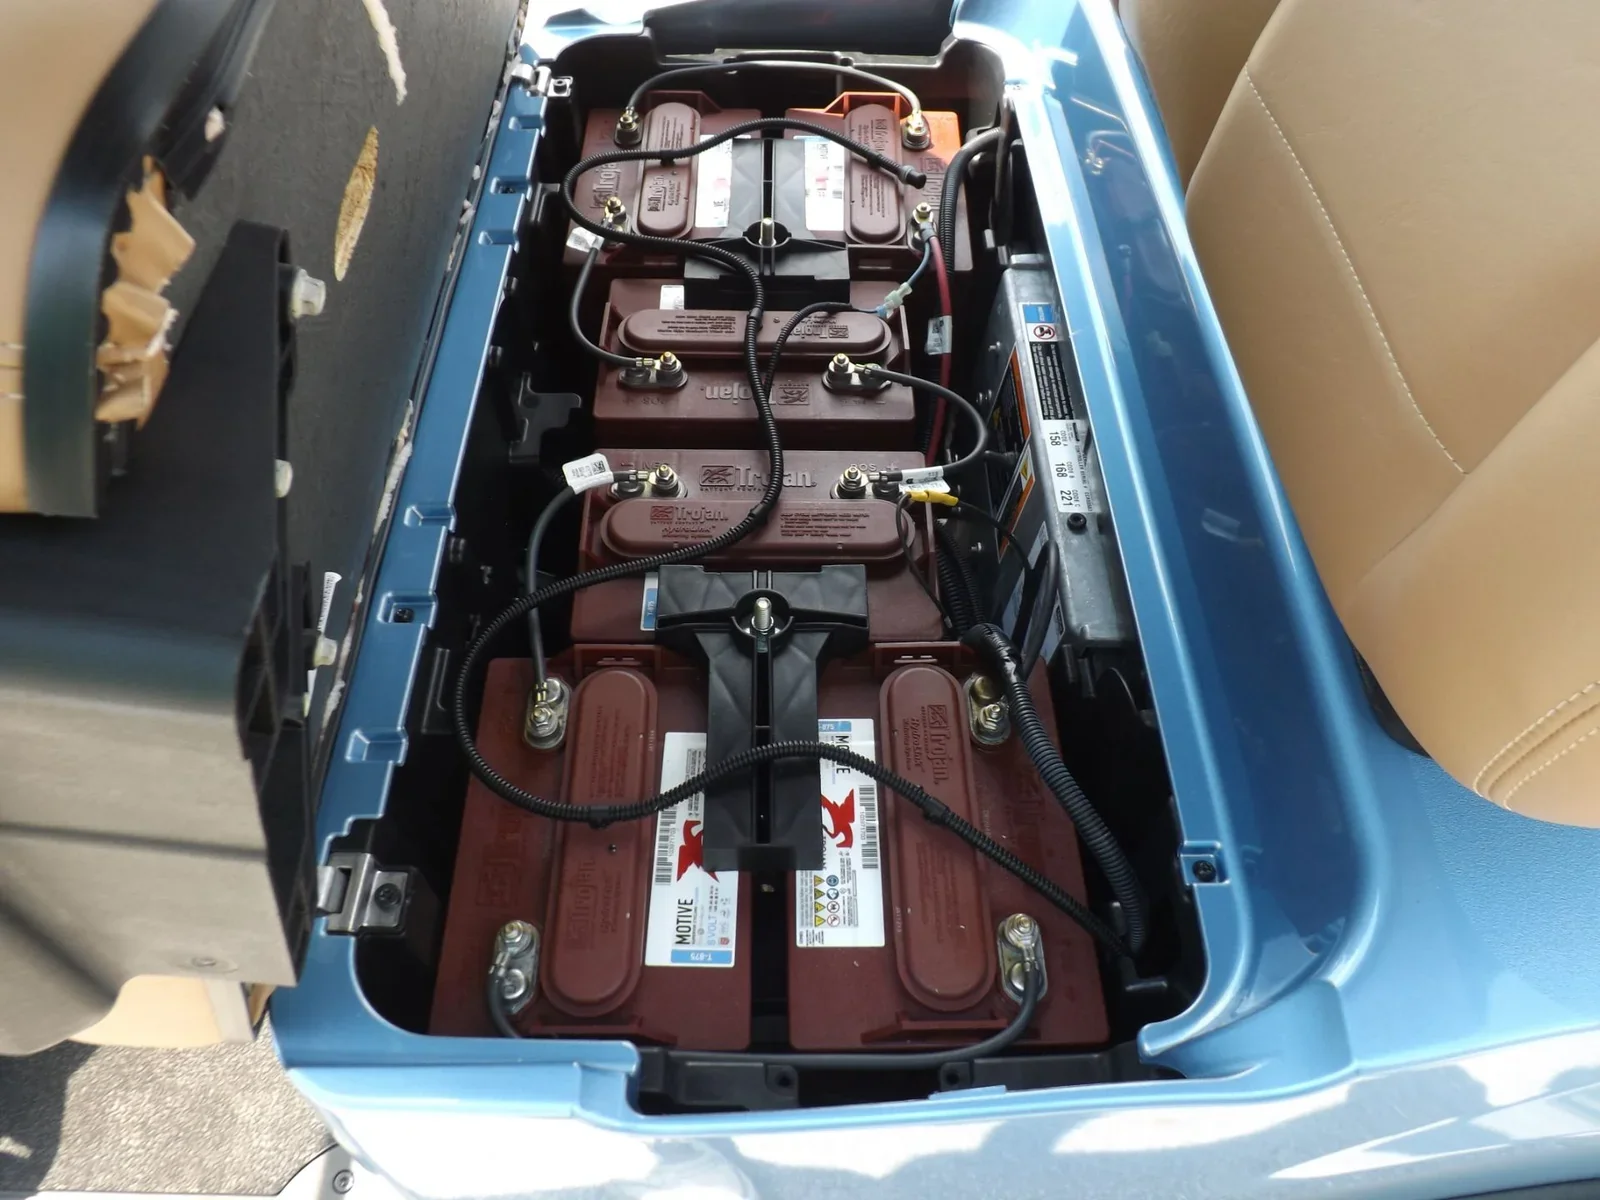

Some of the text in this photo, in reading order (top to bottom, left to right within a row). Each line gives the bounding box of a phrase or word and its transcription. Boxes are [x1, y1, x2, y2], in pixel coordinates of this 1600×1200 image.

[1049, 431, 1062, 447] 158
[735, 465, 812, 488] Troan
[1054, 462, 1068, 478] 168
[1066, 461, 1074, 474] CODE
[1060, 489, 1073, 506] 221
[675, 505, 725, 524] Trojan
[927, 728, 953, 781] Trojan
[675, 898, 694, 945] MOTIVE
[707, 915, 718, 938] VOLT
